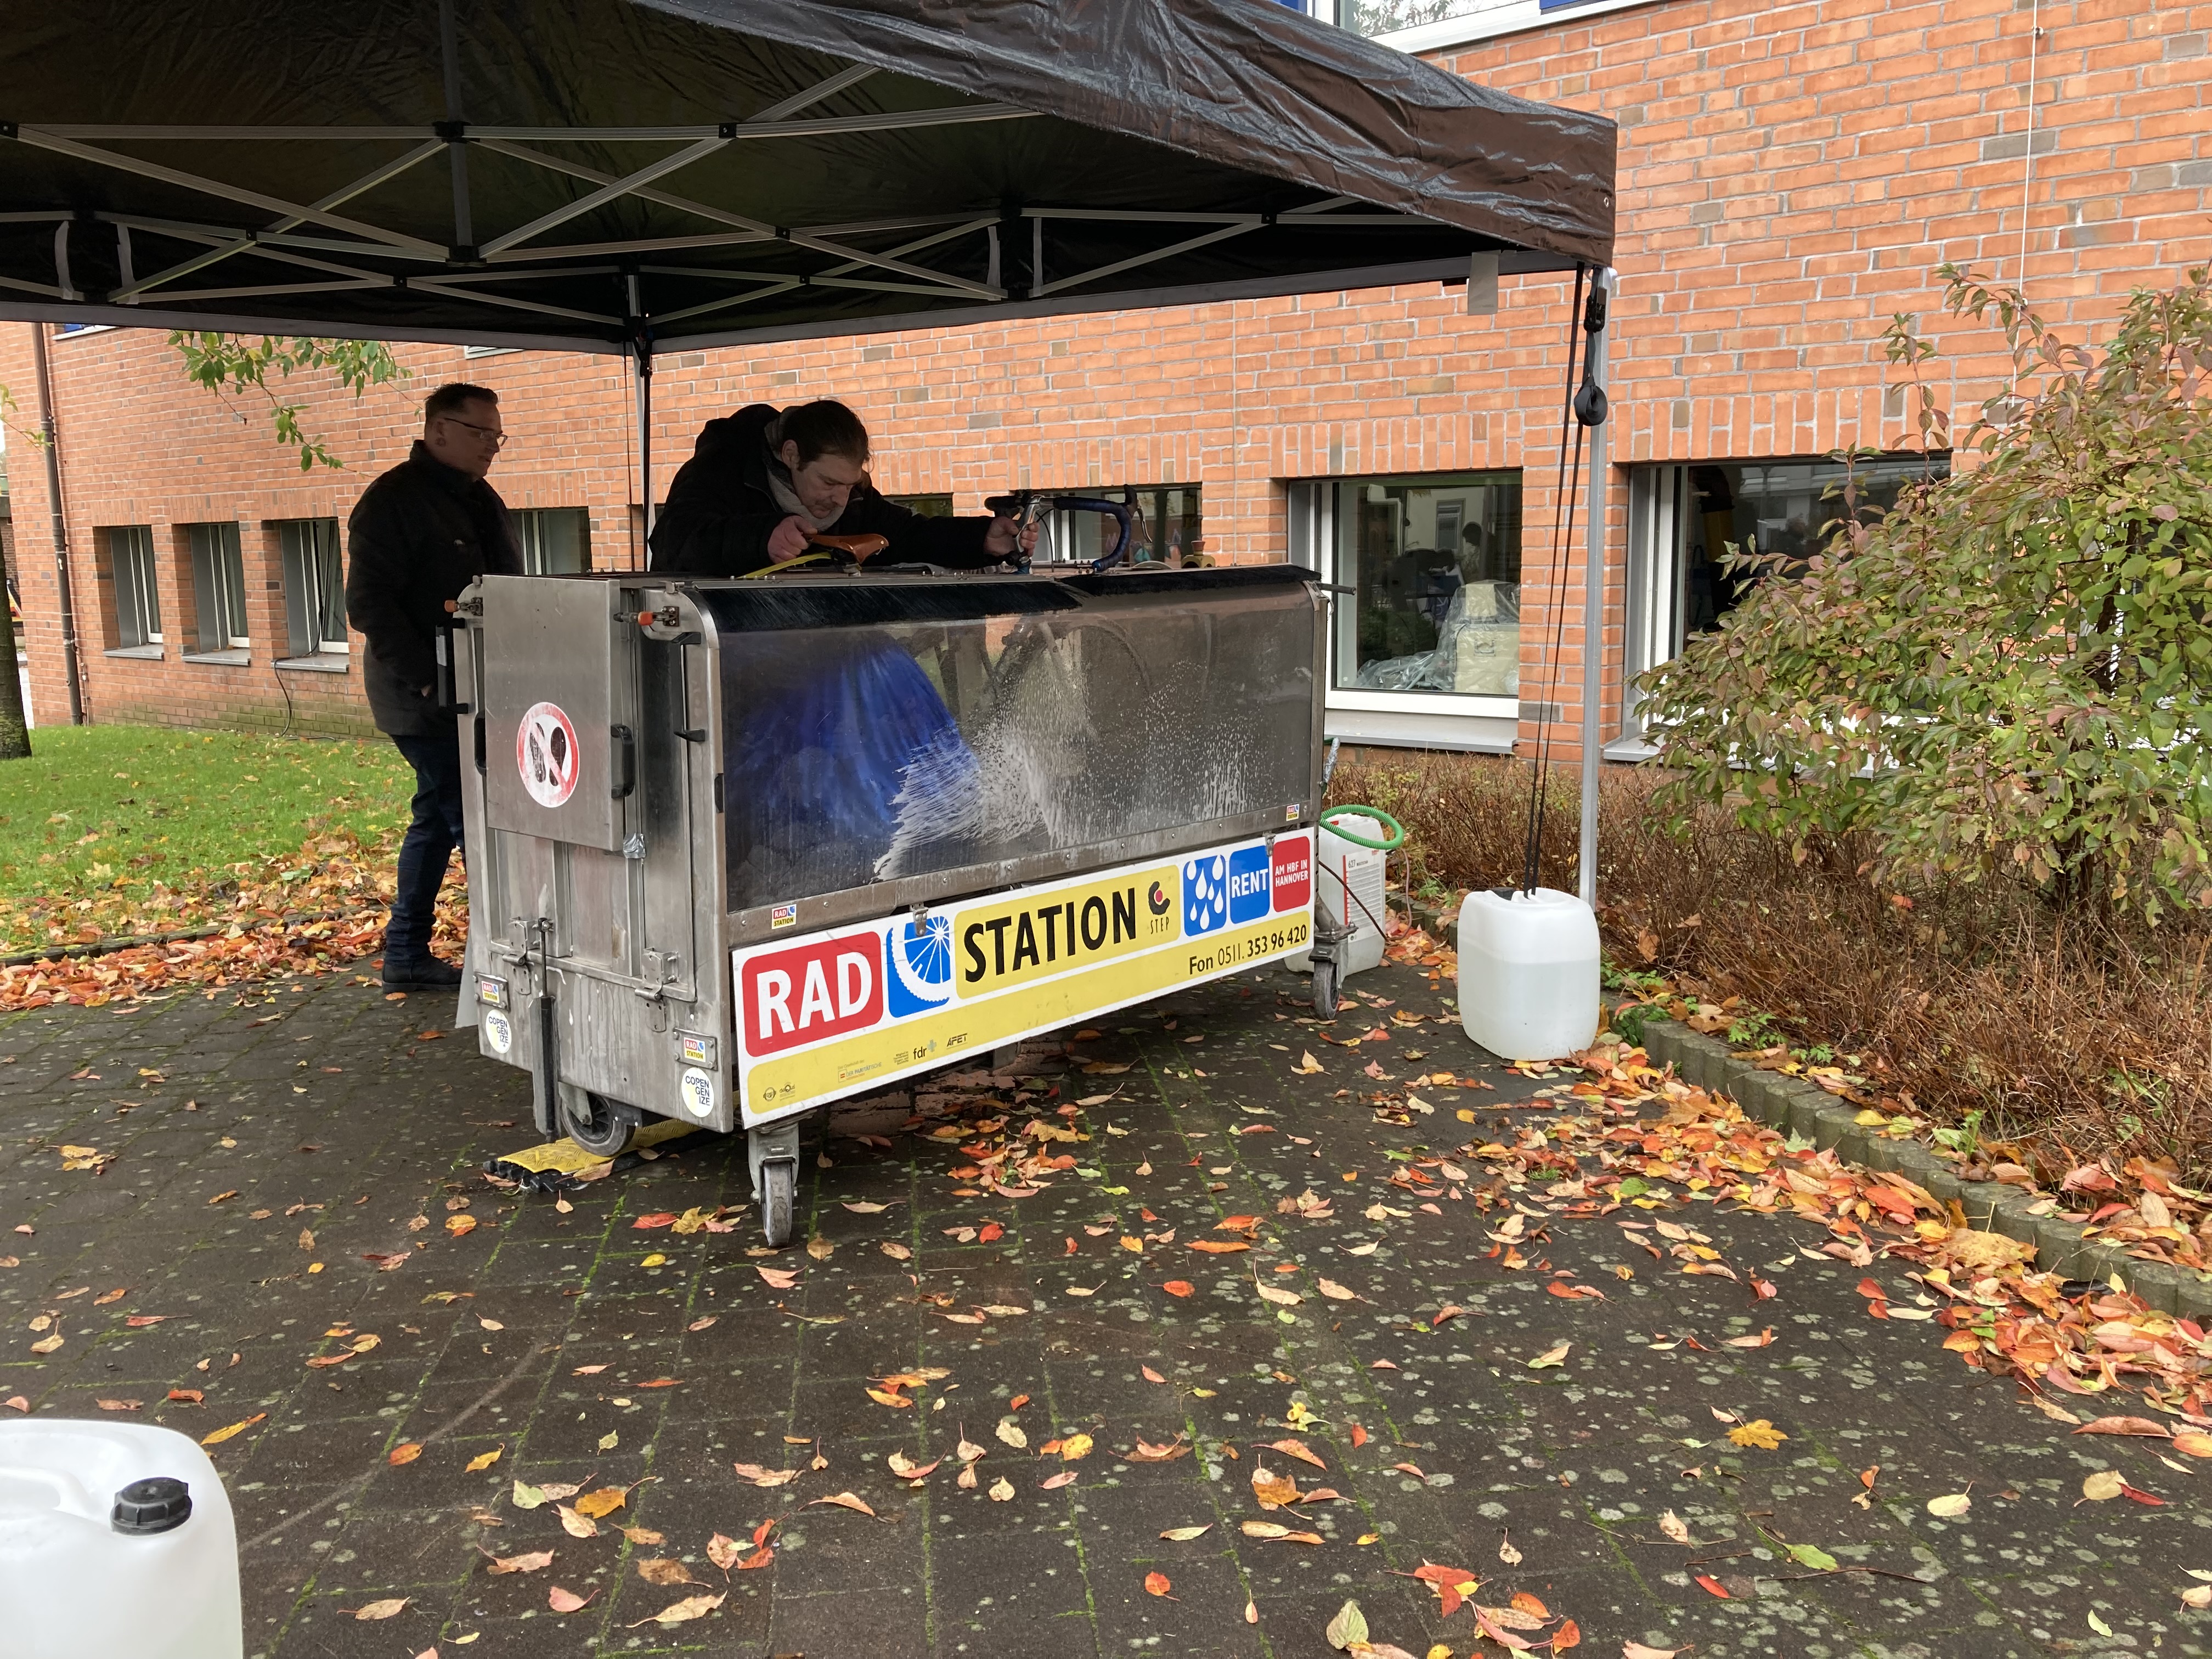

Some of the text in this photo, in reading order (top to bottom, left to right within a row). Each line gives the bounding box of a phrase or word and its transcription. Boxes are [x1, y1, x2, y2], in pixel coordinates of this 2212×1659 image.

[1275, 859, 1307, 876] AM HBF IN
[1232, 868, 1268, 898] RENT
[1275, 870, 1308, 887] HANNOVER
[774, 909, 787, 918] RAD
[774, 917, 794, 927] STATION
[1150, 916, 1169, 935] STEP
[1189, 924, 1307, 975] Fon 0511. 353 96 420
[757, 887, 1136, 1039] RAD STATION
[489, 1016, 507, 1029] COPEN
[496, 1026, 508, 1036] GEN
[500, 1035, 509, 1044] IZE
[686, 1040, 697, 1049] RAD
[947, 1032, 968, 1047] AFET
[686, 1051, 703, 1059] STATION
[913, 1046, 927, 1060] fdr
[685, 1076, 709, 1088] COPEN
[695, 1086, 710, 1097] GEN
[699, 1096, 710, 1106] IZE
